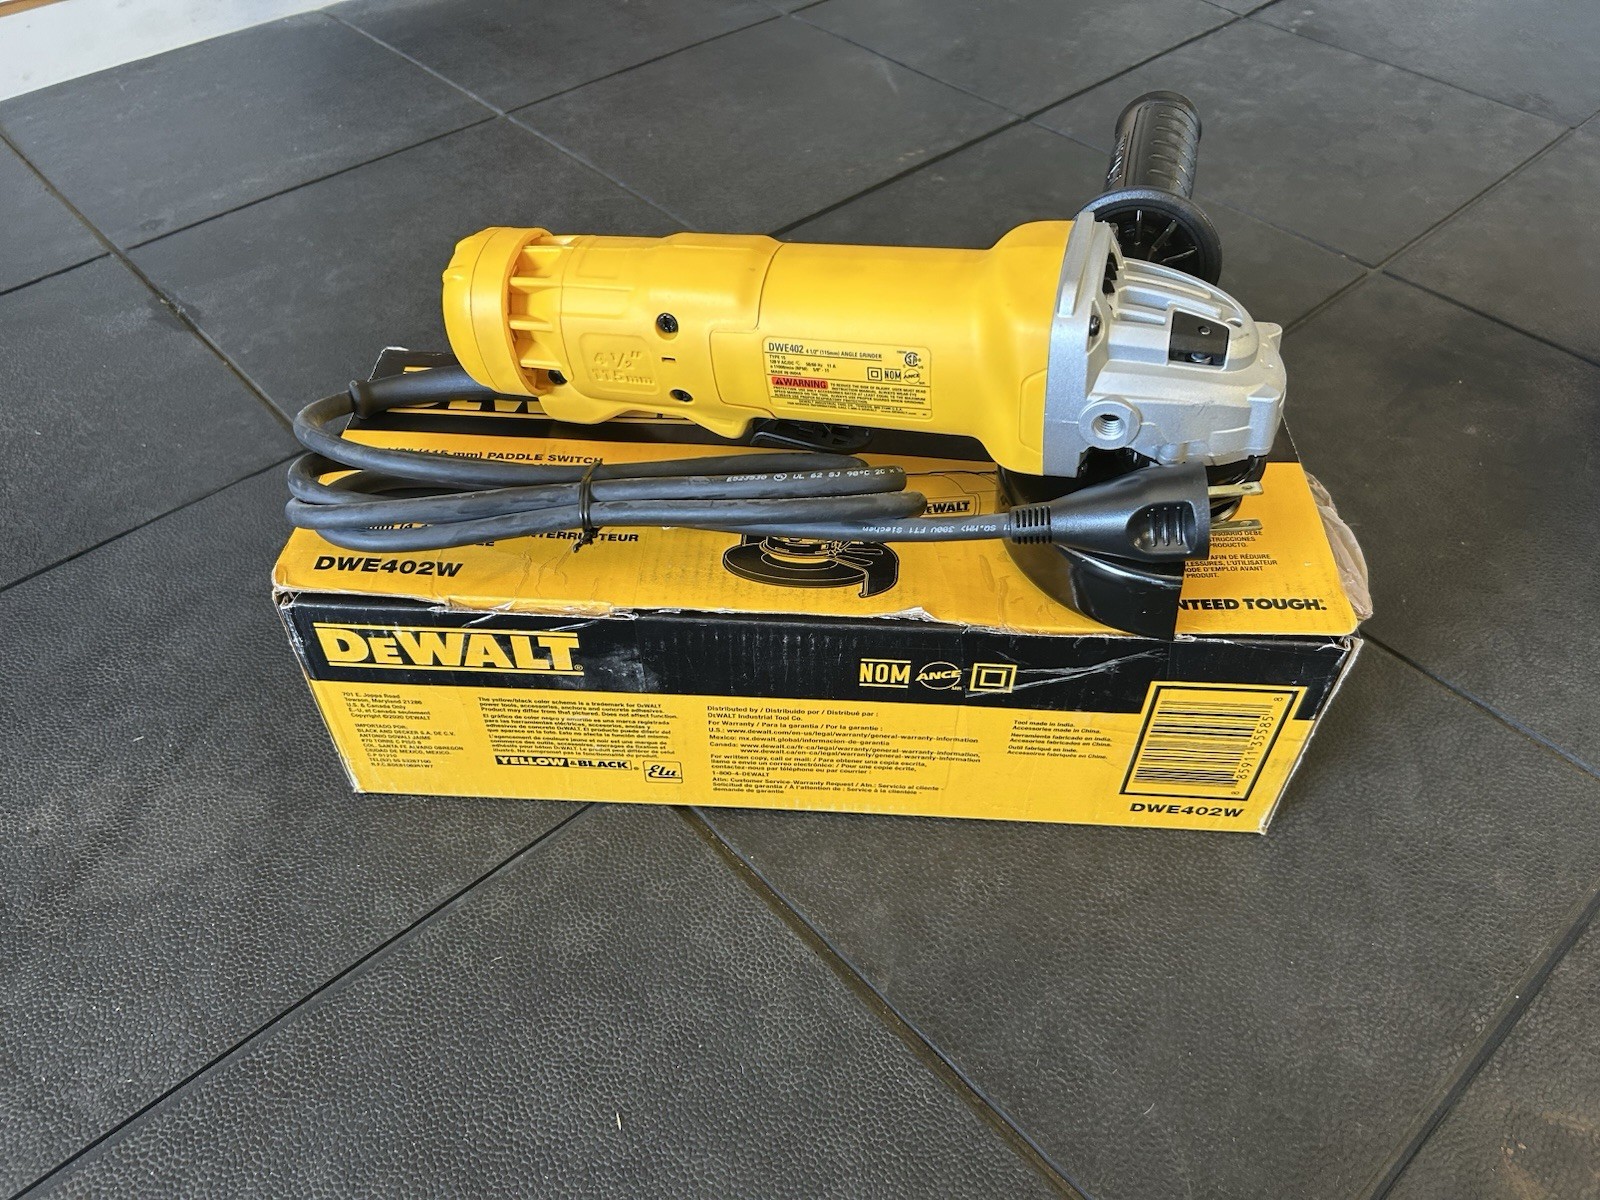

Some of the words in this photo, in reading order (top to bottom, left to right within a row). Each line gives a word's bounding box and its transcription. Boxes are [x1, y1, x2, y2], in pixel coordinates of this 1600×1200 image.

[768, 343, 804, 353] DWE402
[885, 370, 901, 380] NOM
[783, 378, 826, 389] WARNING
[487, 452, 542, 461] PADDLE
[547, 454, 603, 464] SWITCH
[922, 501, 970, 514] EWALT
[314, 556, 463, 577] DWE402W
[1178, 598, 1240, 610] NTEED
[314, 627, 580, 671] DEWALT
[859, 663, 911, 684] NOM
[916, 670, 962, 681] ANCE
[498, 757, 566, 766] YELLOW
[578, 760, 628, 769] BLACK
[1130, 803, 1244, 817] DWE402W
